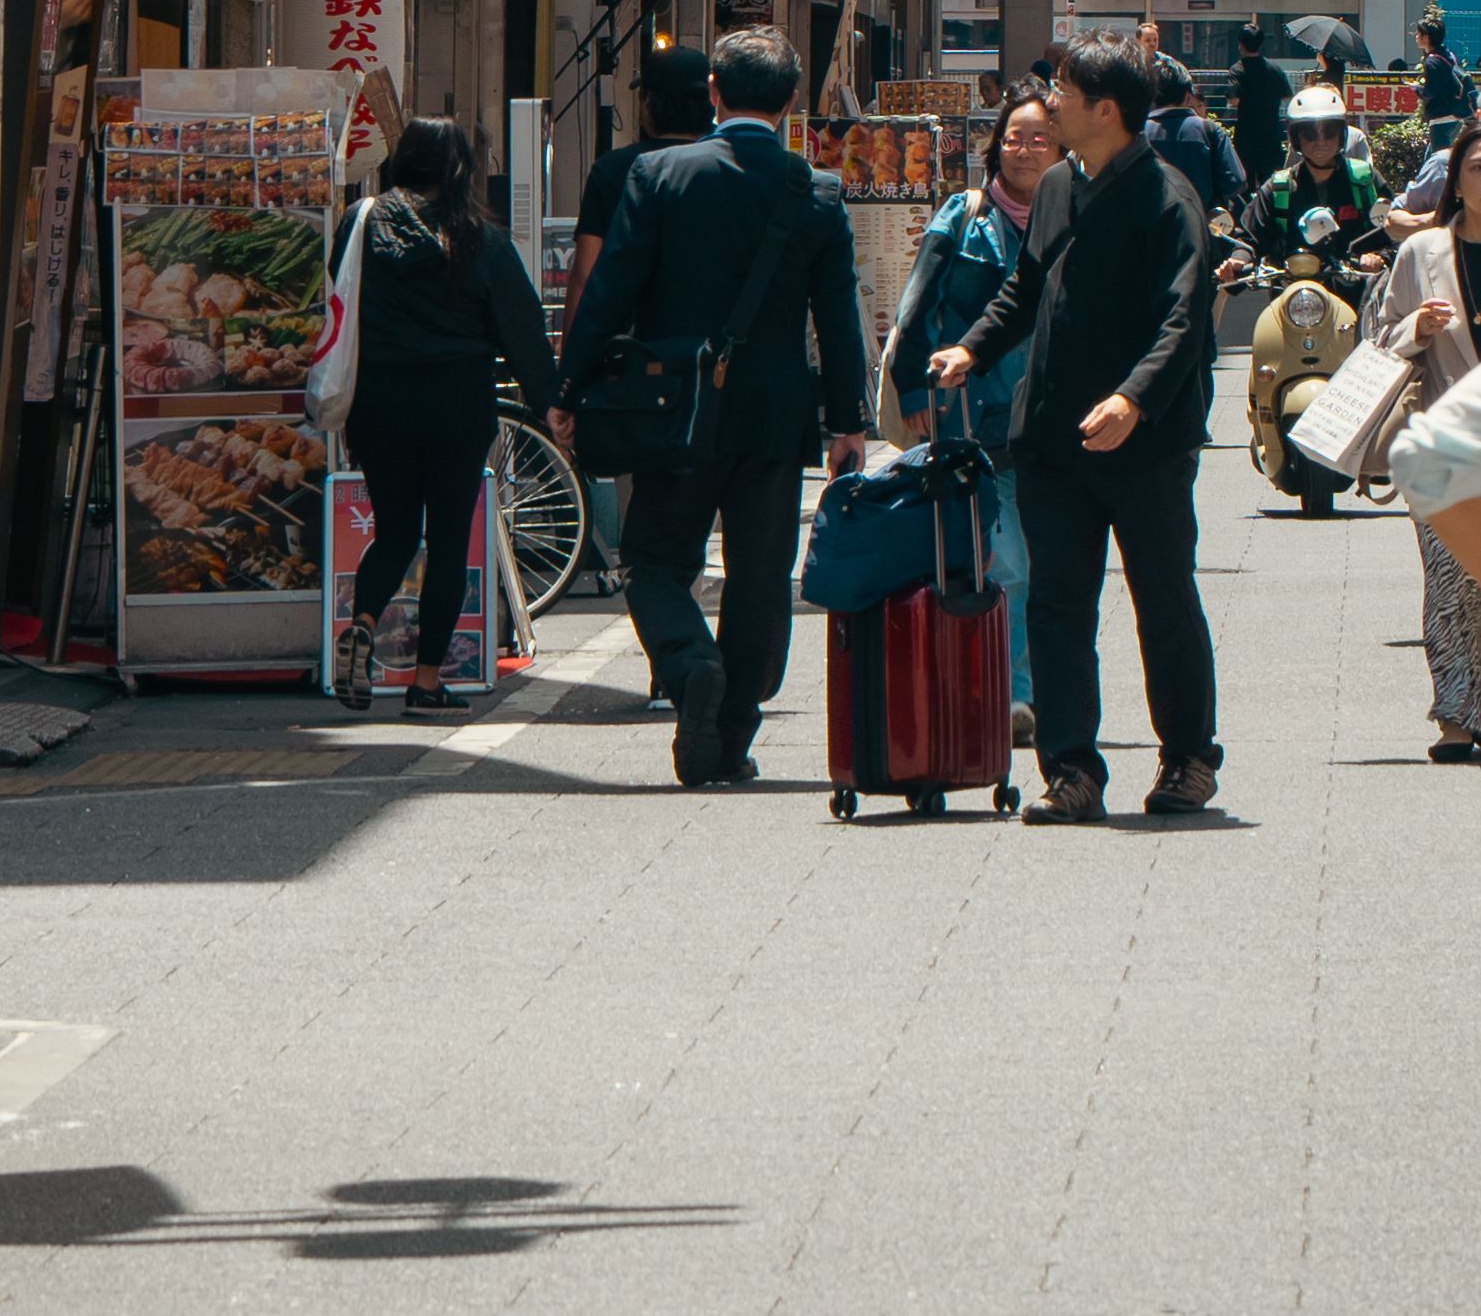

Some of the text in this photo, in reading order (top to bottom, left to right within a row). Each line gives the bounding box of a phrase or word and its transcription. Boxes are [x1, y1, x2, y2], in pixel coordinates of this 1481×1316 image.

[845, 182, 929, 200] 炭火焼き鳥
